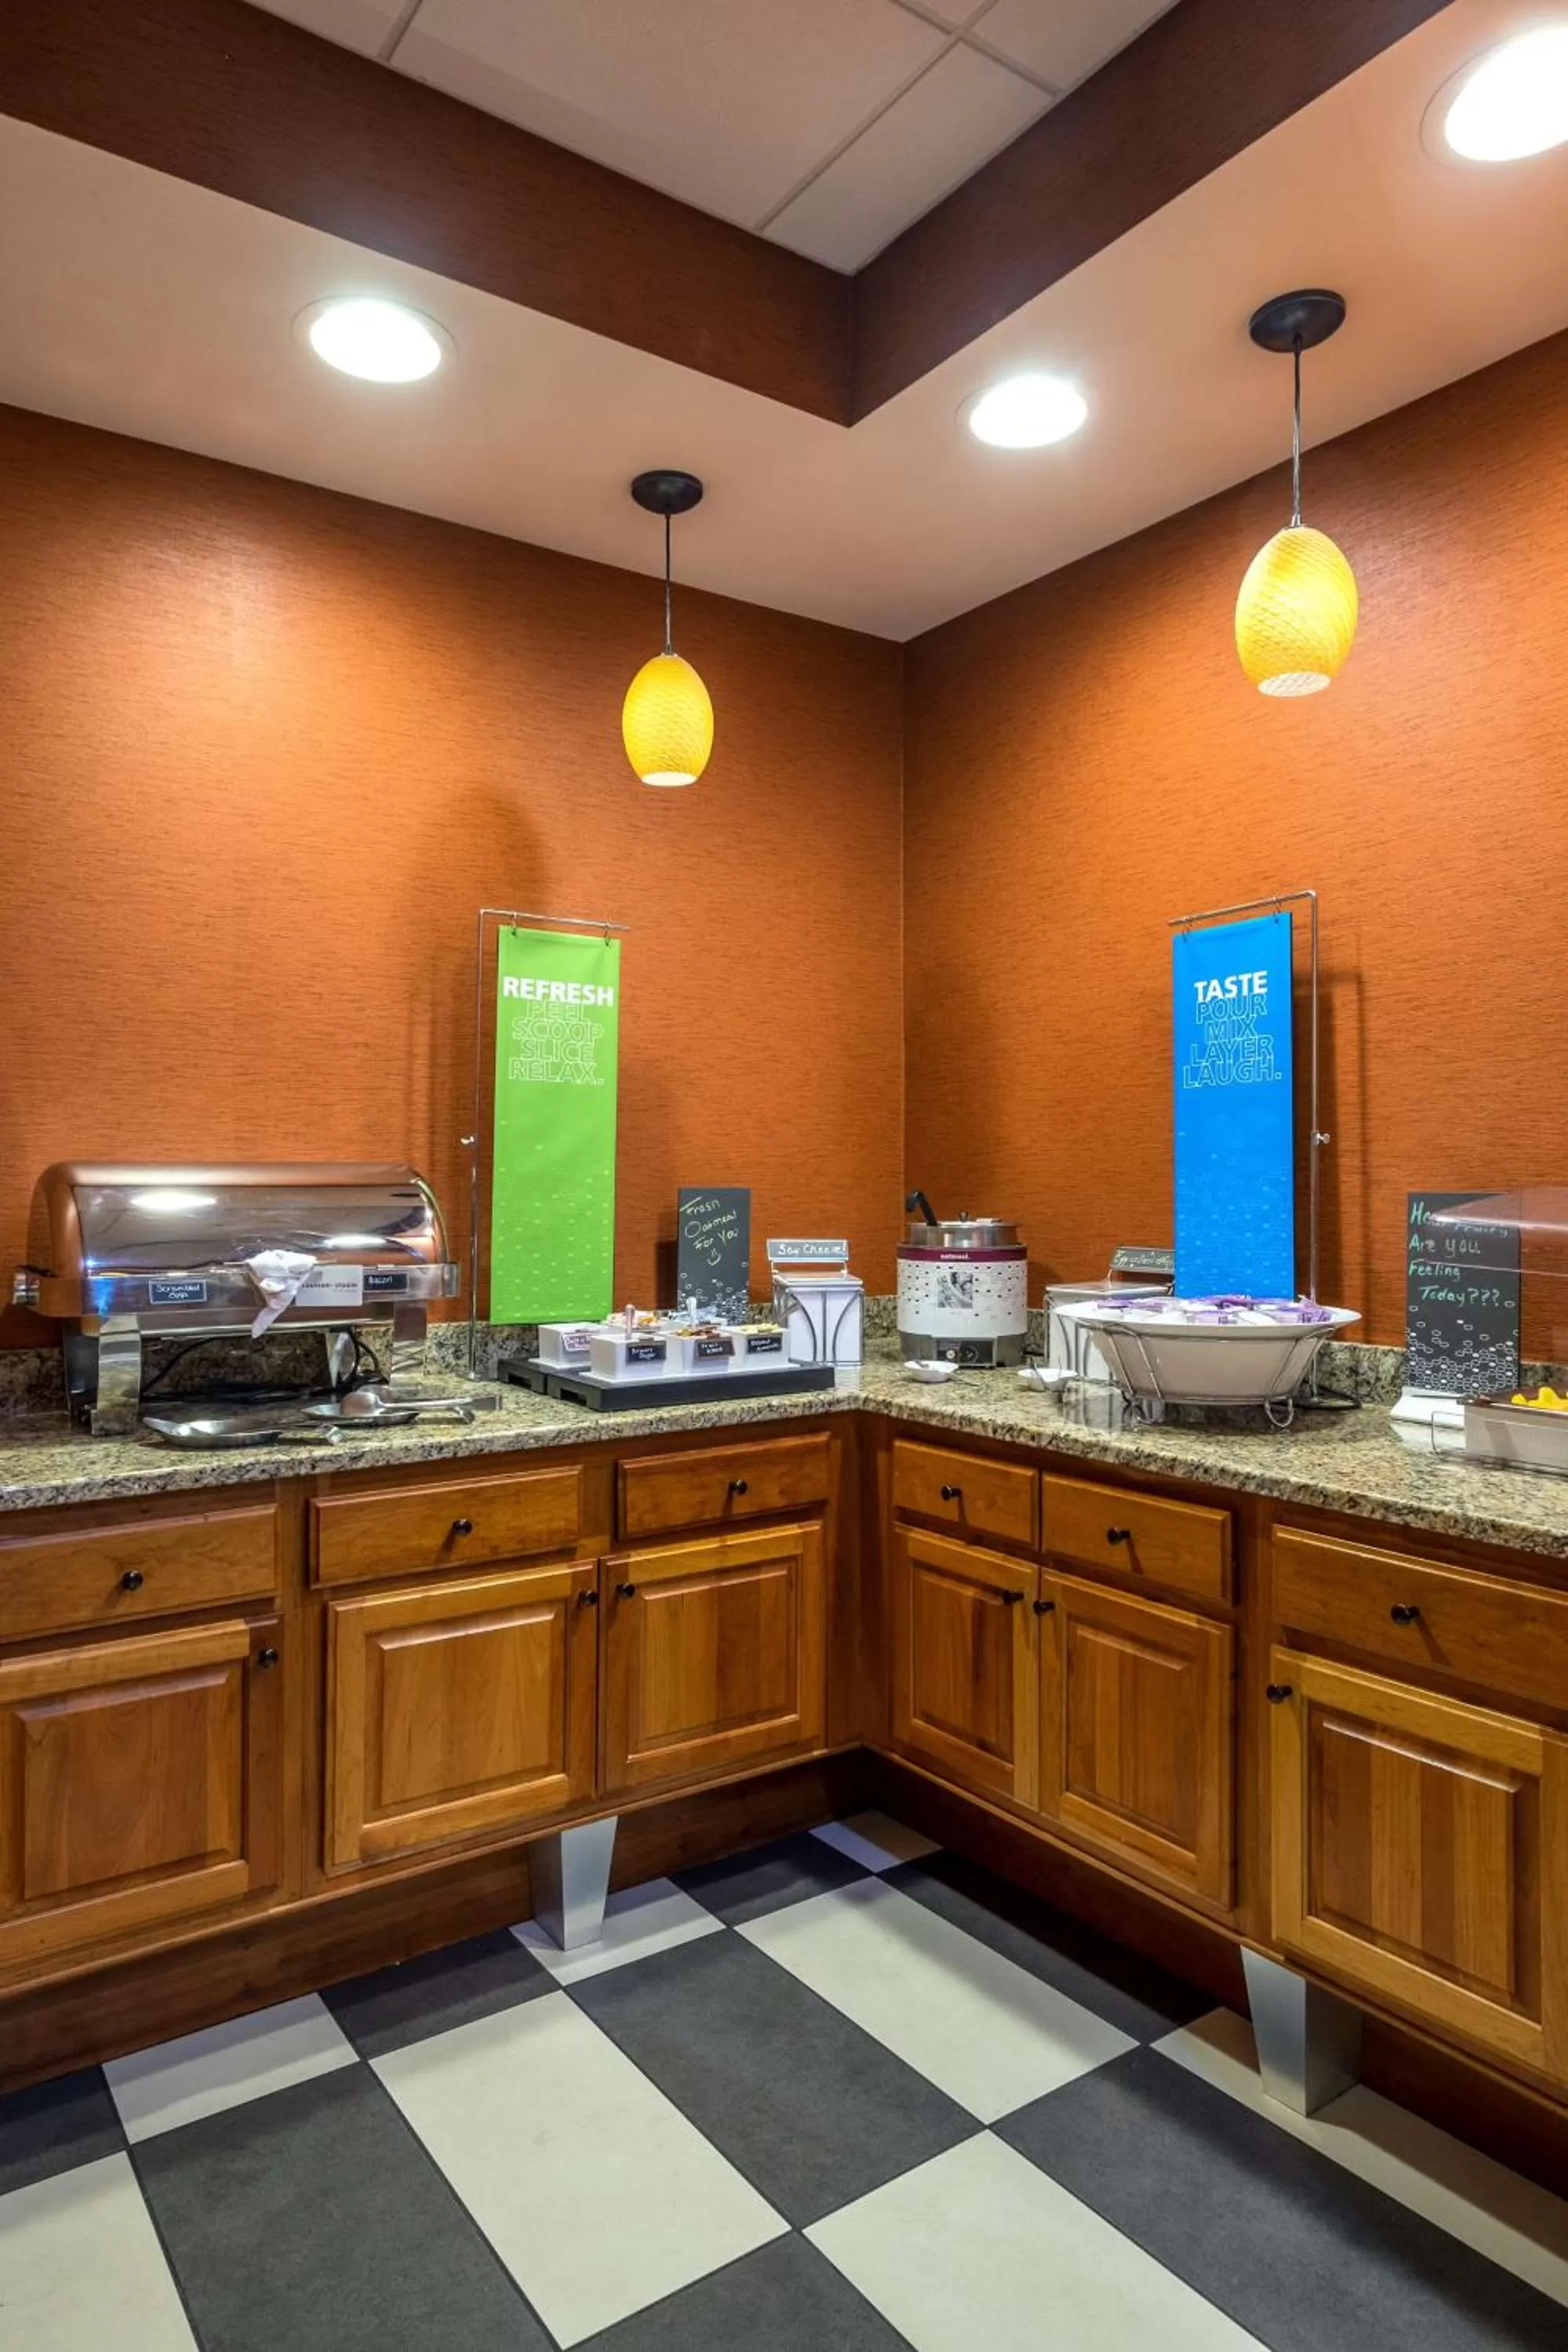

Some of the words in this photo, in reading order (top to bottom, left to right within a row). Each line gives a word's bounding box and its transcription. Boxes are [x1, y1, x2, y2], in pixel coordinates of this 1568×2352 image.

[503, 976, 614, 1007] REFRESH
[1193, 971, 1267, 1003] TASTE
[1196, 993, 1267, 1025] POUR
[512, 1018, 604, 1044] SCOOP
[1204, 1014, 1258, 1045] MIX
[520, 1038, 595, 1063] SLICE
[1191, 1035, 1274, 1066] LAYER
[508, 1056, 604, 1086] RELAX.
[1182, 1057, 1282, 1088] LAUGH.
[692, 1236, 714, 1250] For
[778, 1243, 800, 1258] Say
[1409, 1233, 1436, 1252] Are
[1409, 1258, 1461, 1282] Feeling
